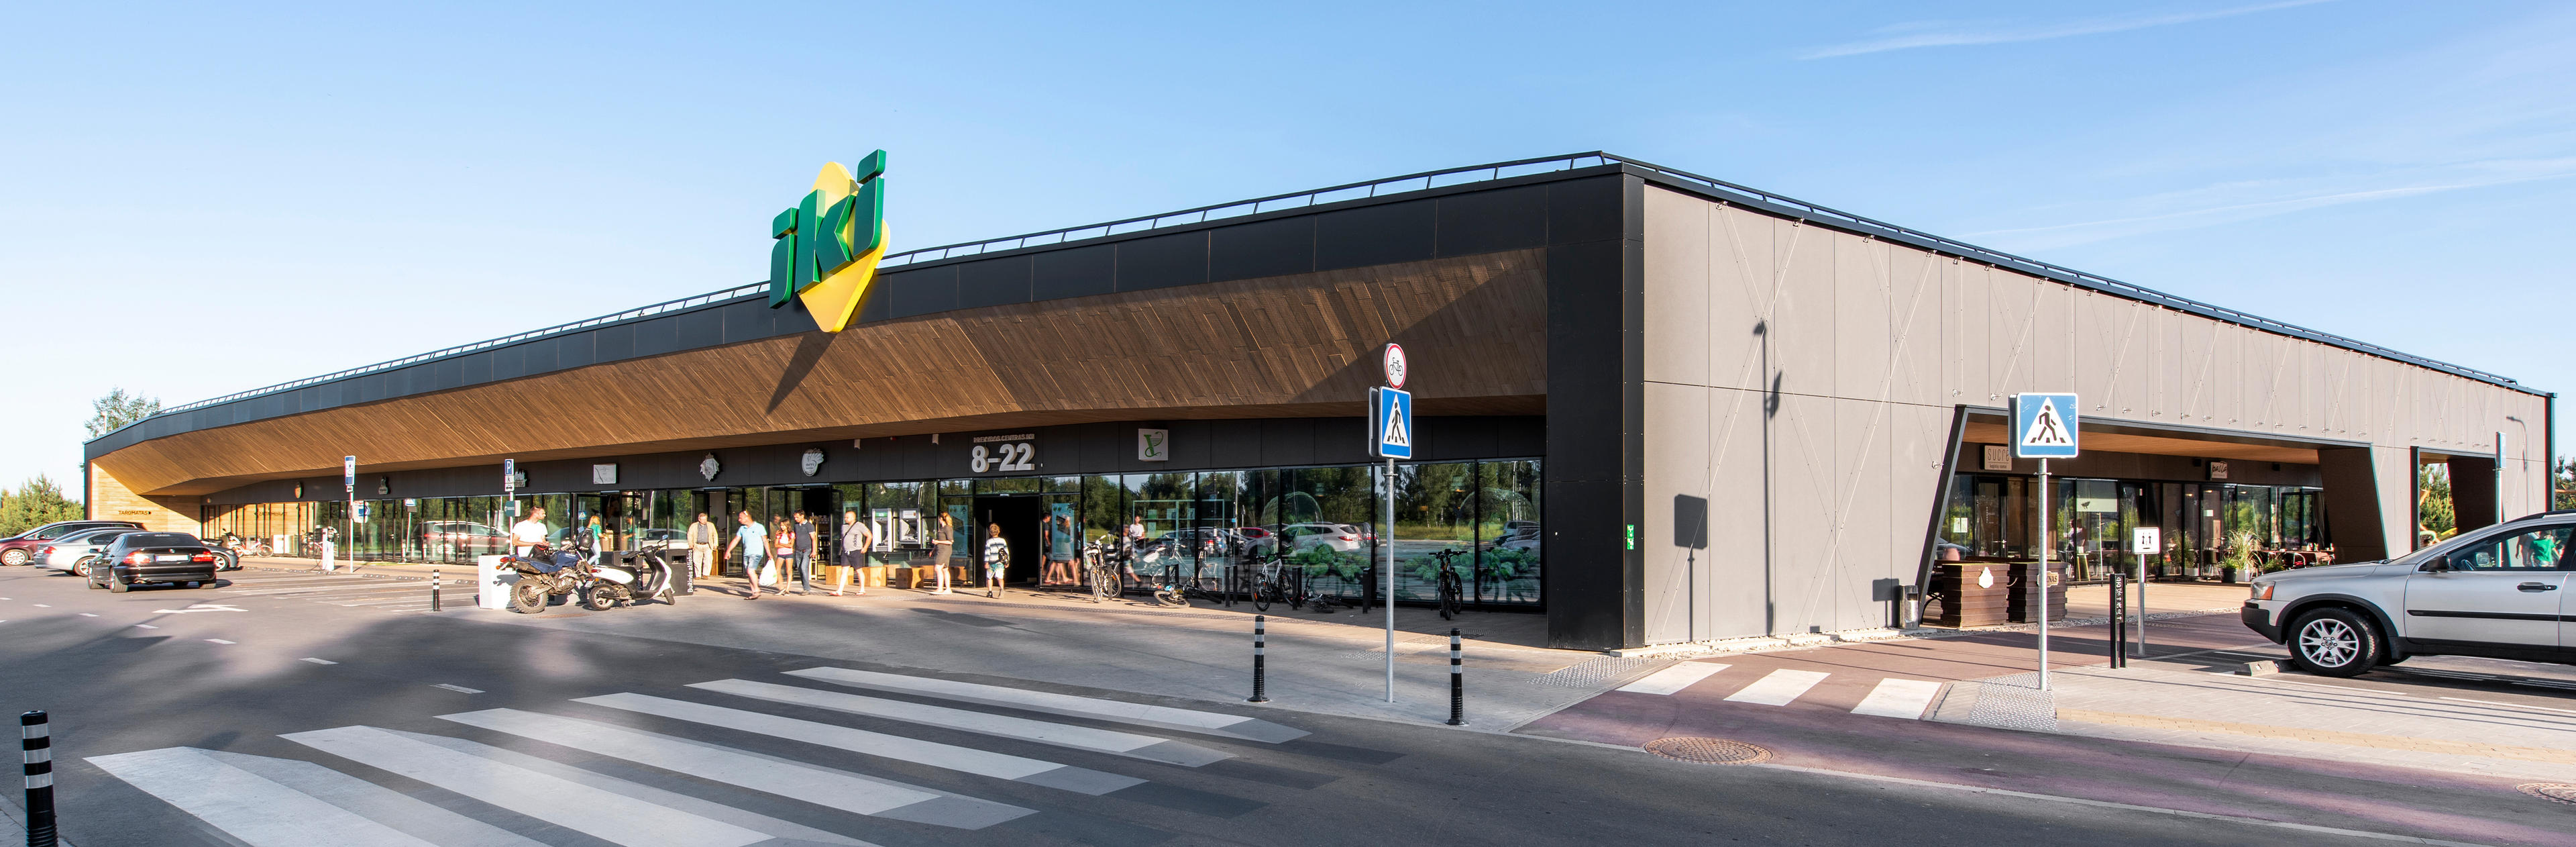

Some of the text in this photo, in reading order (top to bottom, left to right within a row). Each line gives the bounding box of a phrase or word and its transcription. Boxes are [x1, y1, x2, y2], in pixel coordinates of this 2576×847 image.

[769, 149, 886, 309] iki
[506, 460, 512, 474] P
[971, 443, 1035, 472] 8-22
